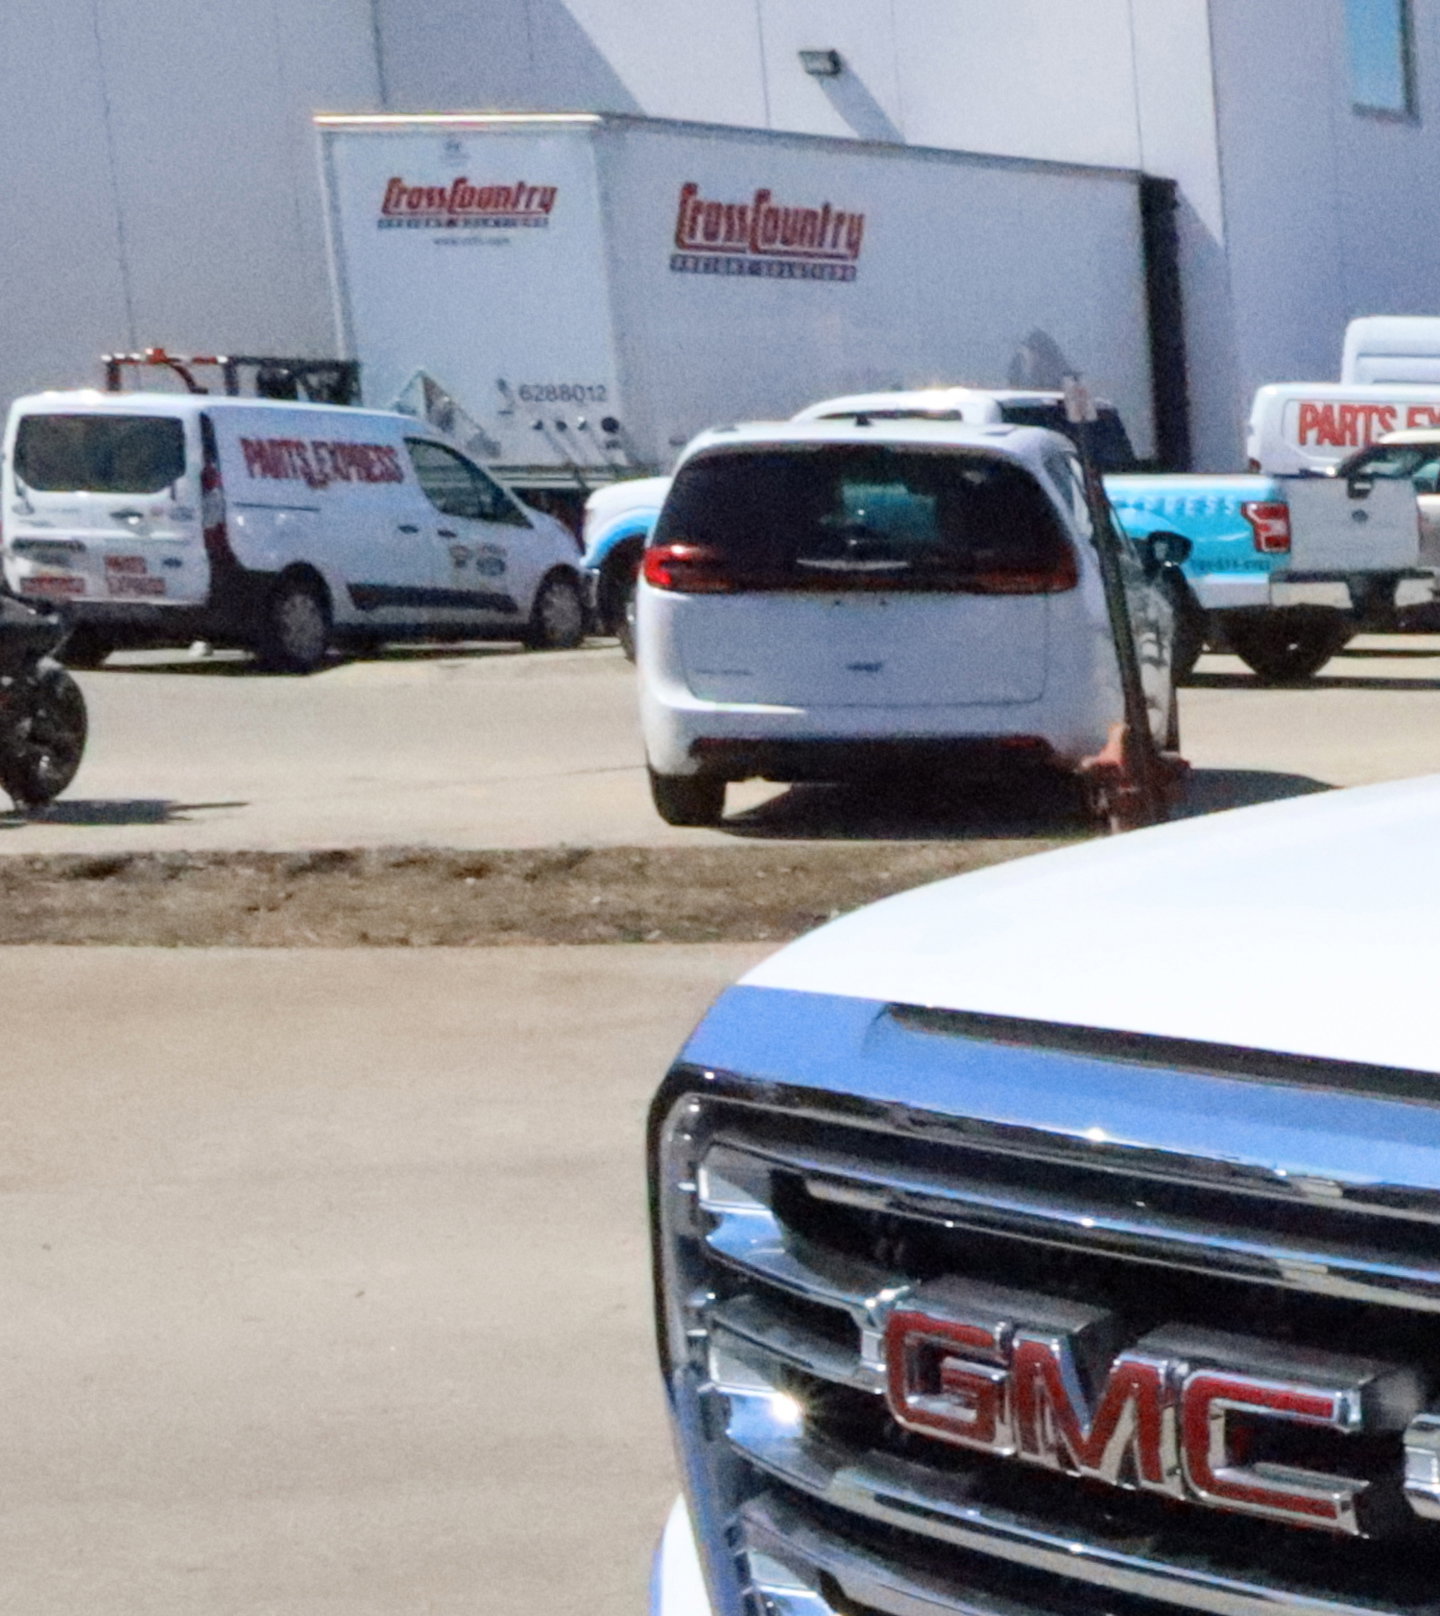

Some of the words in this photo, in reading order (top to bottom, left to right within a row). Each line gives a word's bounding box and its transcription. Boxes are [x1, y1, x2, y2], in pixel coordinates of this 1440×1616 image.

[382, 176, 558, 216] CrossCountry
[675, 182, 864, 260] CrossCountry
[1298, 403, 1398, 447] PARTS
[886, 1305, 1368, 1537] GMC
